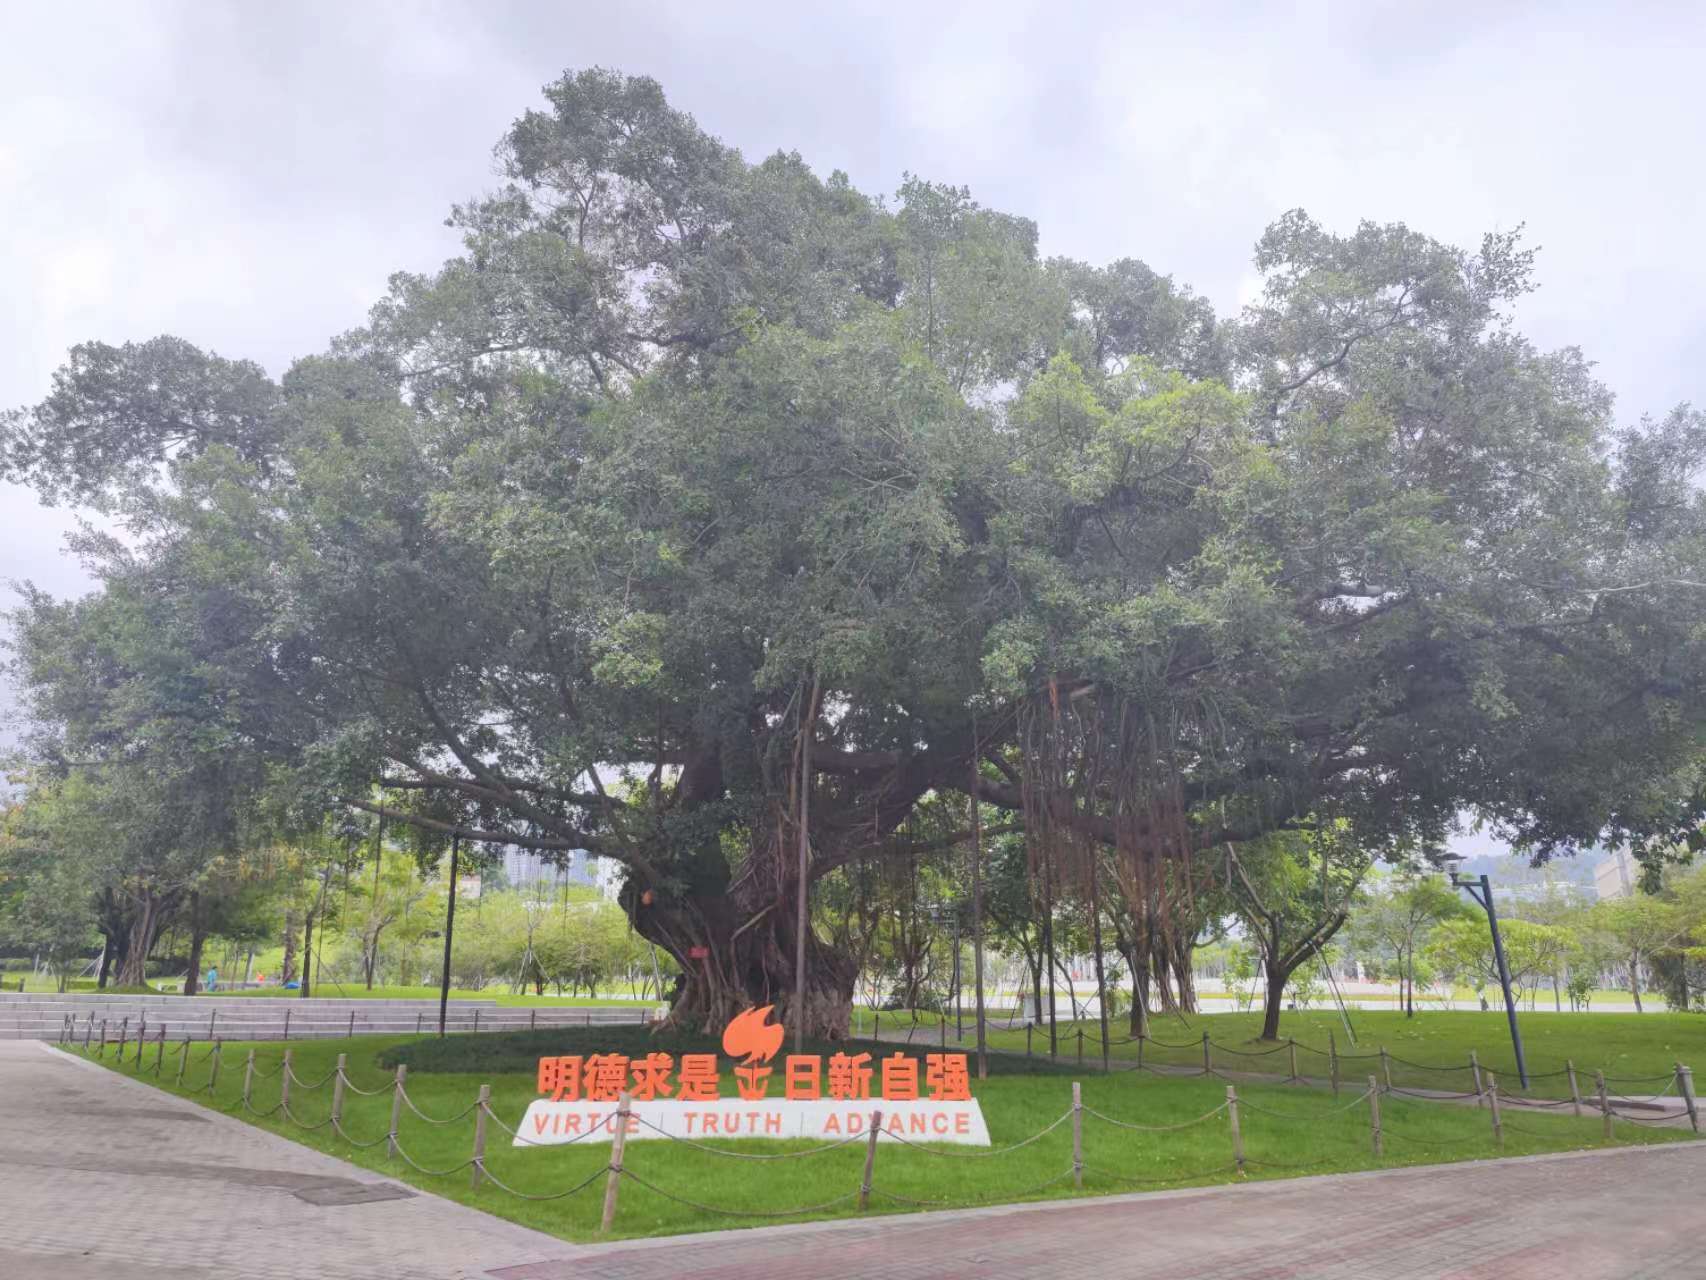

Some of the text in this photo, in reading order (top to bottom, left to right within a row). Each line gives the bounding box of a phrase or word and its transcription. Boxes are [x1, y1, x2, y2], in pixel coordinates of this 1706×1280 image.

[538, 1052, 971, 1101] 明德求是 日新自强
[684, 1112, 782, 1134] TRUTH
